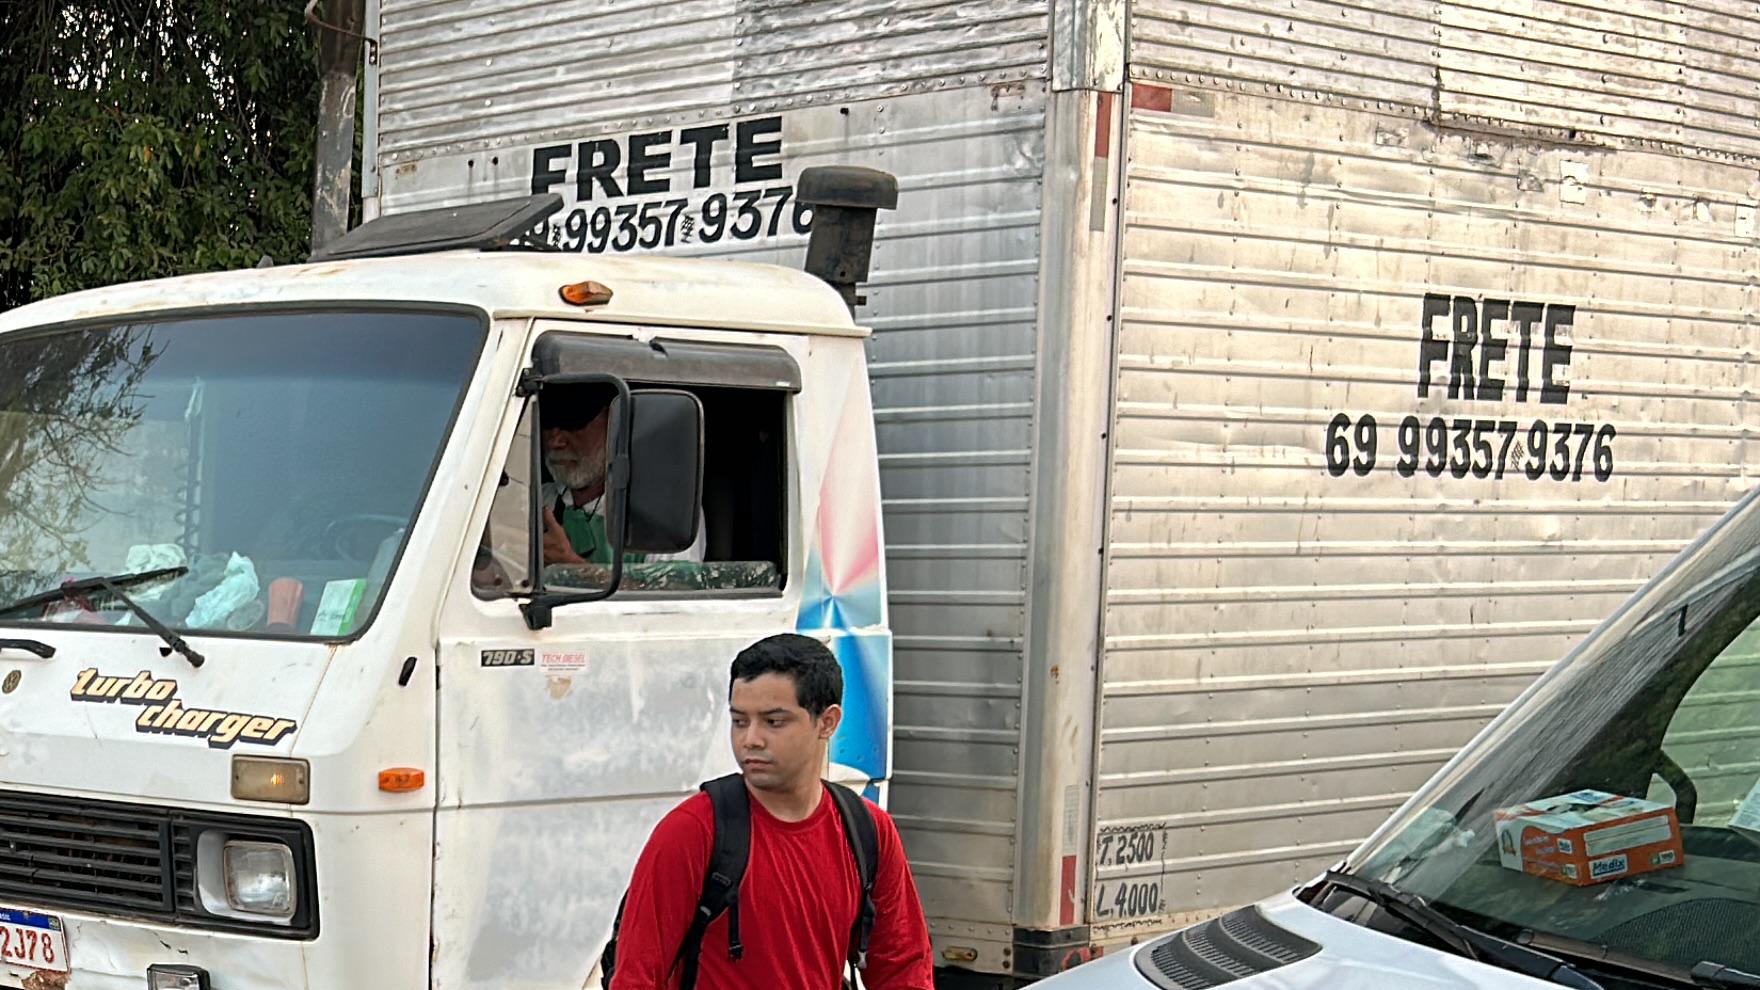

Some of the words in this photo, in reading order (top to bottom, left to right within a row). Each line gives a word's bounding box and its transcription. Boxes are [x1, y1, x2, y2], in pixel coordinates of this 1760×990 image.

[531, 116, 784, 201] FRETE
[1418, 292, 1577, 405] FRETE
[1326, 413, 1378, 478] 69
[71, 667, 179, 704] turbo
[136, 699, 298, 749] charger
